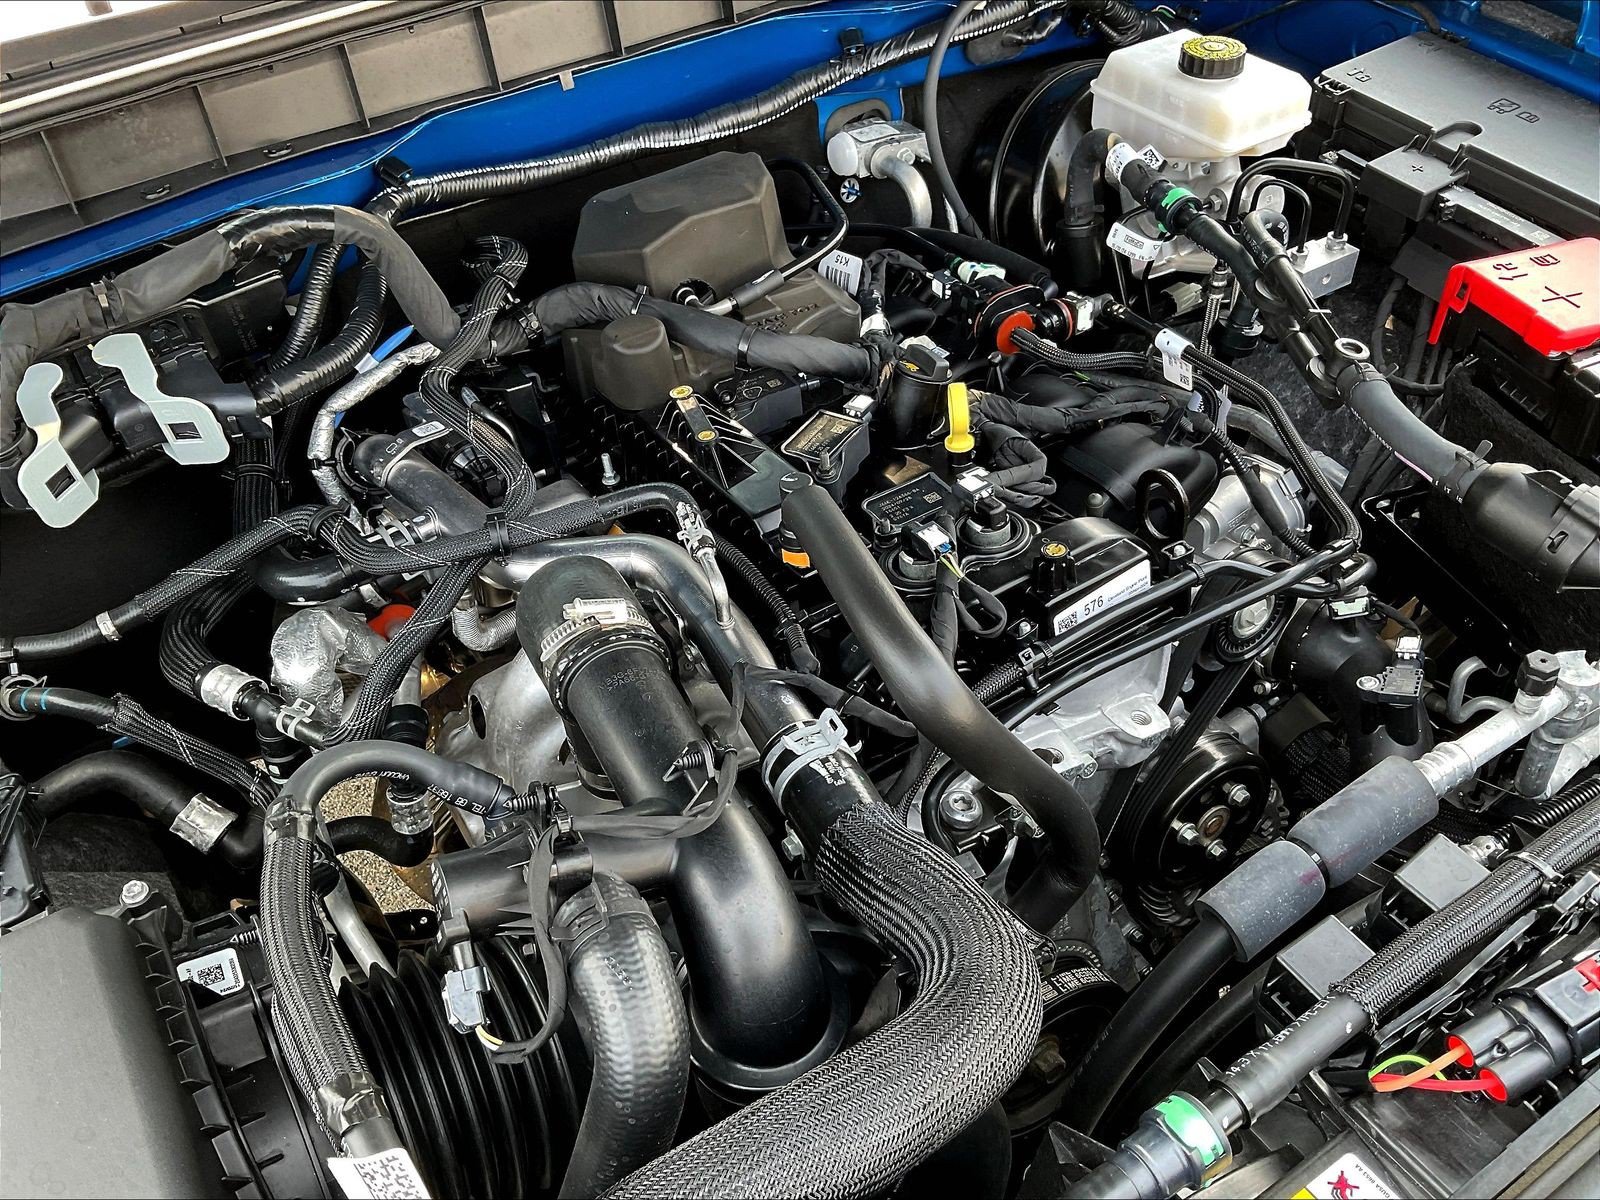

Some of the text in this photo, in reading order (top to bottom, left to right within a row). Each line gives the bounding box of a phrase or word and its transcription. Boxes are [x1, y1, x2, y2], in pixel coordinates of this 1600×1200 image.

[834, 254, 850, 268] K15
[1083, 595, 1104, 617] 576
[454, 796, 468, 807] GB
[1225, 1057, 1251, 1078] 14.3
[1355, 1163, 1364, 1172] AA
[1375, 1183, 1391, 1199] GUSA
